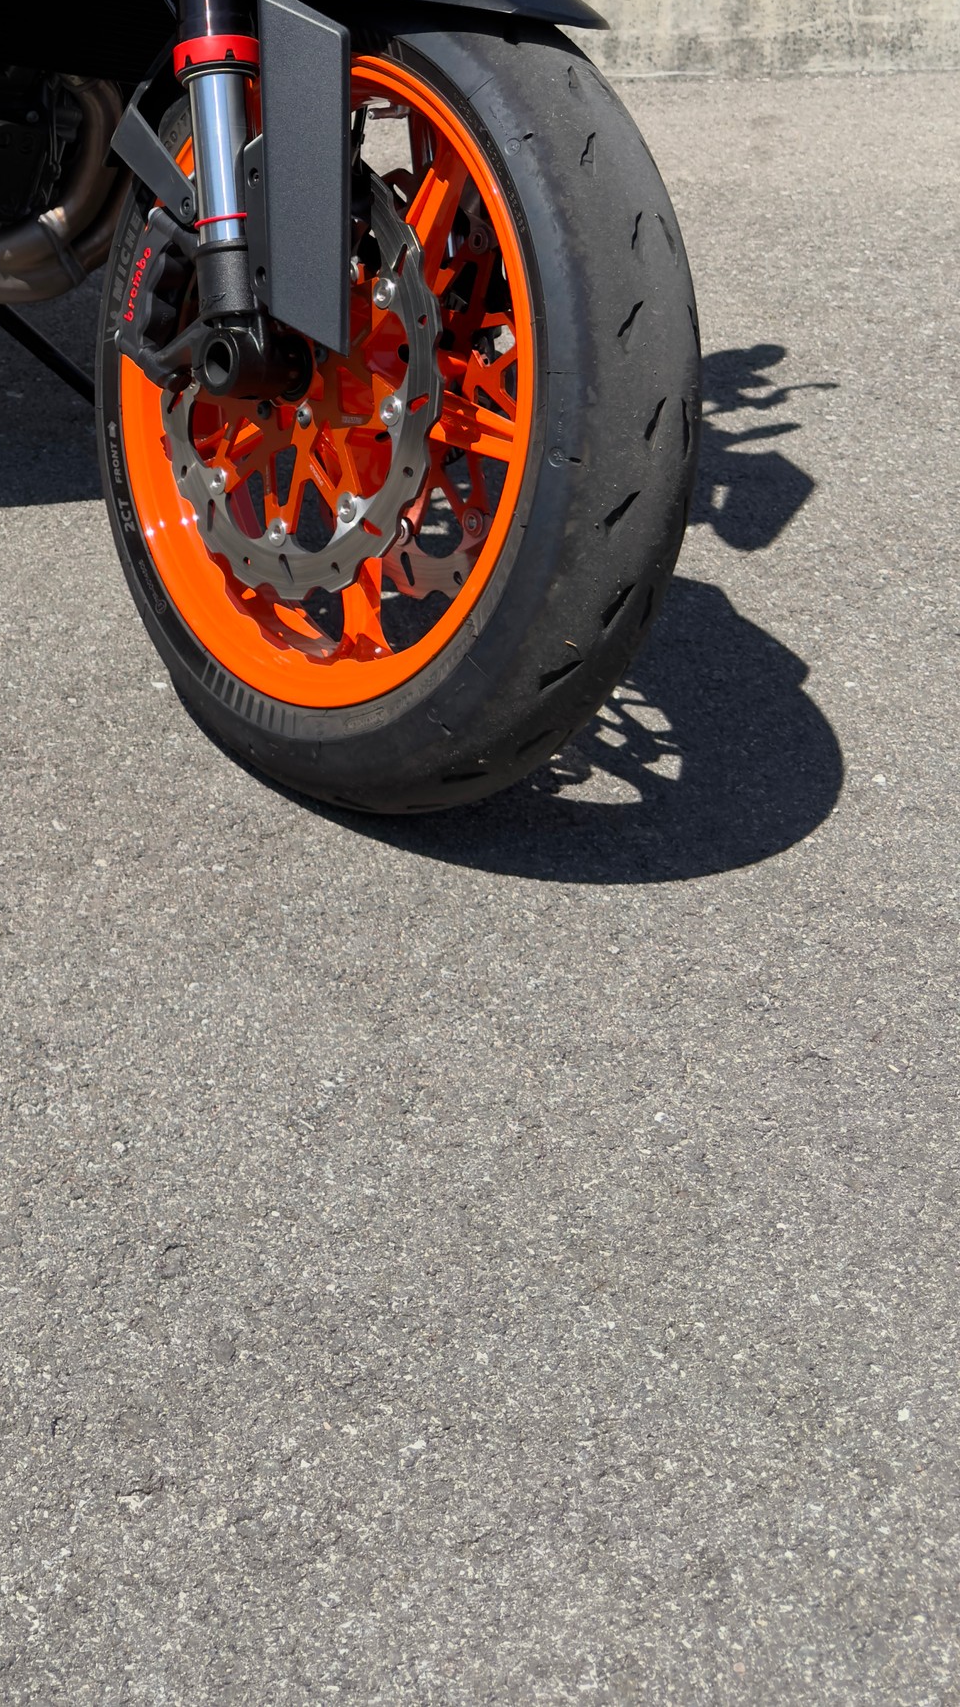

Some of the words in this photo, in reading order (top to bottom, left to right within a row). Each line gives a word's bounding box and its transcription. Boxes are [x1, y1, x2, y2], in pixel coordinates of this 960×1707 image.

[112, 213, 141, 302] MICHE
[113, 442, 123, 484] FRONT
[118, 497, 136, 533] 2CT
